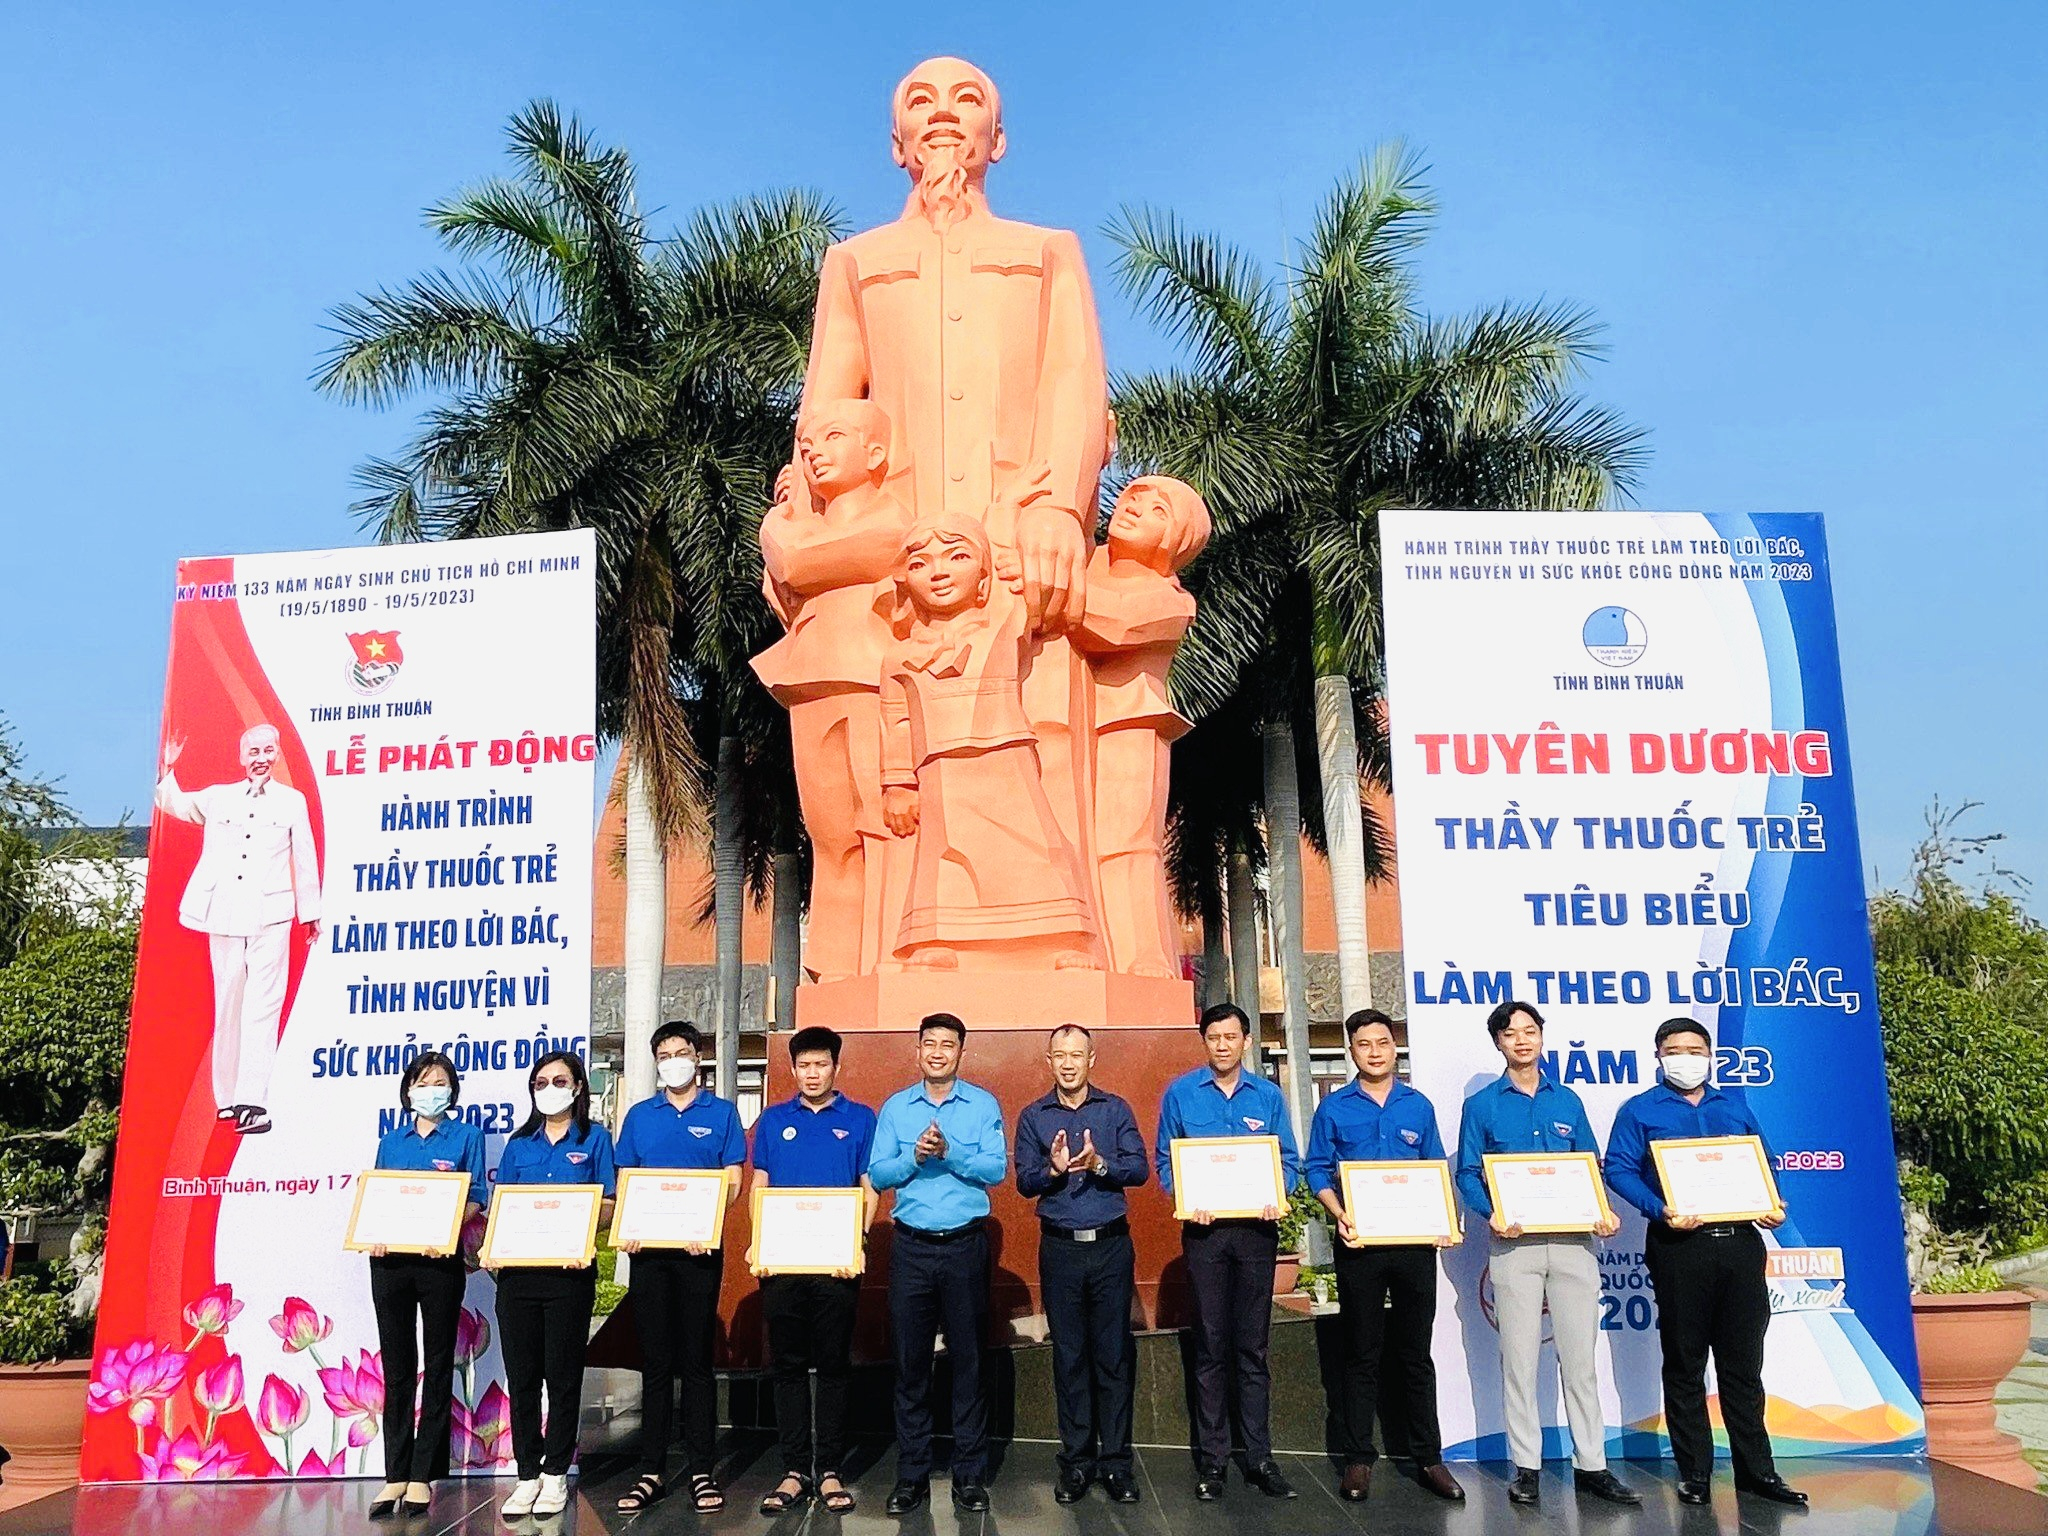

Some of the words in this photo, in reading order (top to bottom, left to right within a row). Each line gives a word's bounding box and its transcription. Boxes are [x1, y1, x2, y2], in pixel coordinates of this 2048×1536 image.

[1405, 538, 1447, 555] HÀNH
[1454, 538, 1502, 555] TRÌNH
[1509, 535, 1549, 555] THẦY
[1556, 535, 1610, 555] THUỐC
[1617, 536, 1645, 555] TRẺ
[1652, 537, 1683, 555] LÀM
[1689, 540, 1729, 555] THEO
[1766, 536, 1804, 557] BÁC,
[244, 581, 269, 596] 133
[314, 573, 352, 590] NGÀY
[359, 571, 394, 587] SINH
[438, 564, 472, 582] TỊCH
[507, 557, 533, 575] CHÍ
[540, 555, 580, 573] MINH
[1405, 563, 1442, 580] TÌNH
[1450, 563, 1512, 582] NGUYỆN
[1519, 563, 1535, 580] VÌ
[1541, 563, 1574, 580] SỨC
[1581, 561, 1622, 580] KHỎE
[1629, 562, 1672, 582] CỘNG
[1770, 563, 1812, 580] 2023
[1594, 673, 1630, 690] BÌNH
[1634, 672, 1684, 693] THUẬN
[347, 702, 381, 720] BÌNH
[386, 698, 432, 719] THUẬN
[326, 734, 366, 776] LỄ
[379, 735, 478, 773] PHÁT
[488, 730, 594, 773] ĐỘNG
[1414, 721, 1610, 775] TUYÊN
[1630, 728, 1832, 776] DƯƠNG
[381, 794, 450, 831] HÀNH
[457, 789, 533, 827] TRÌNH
[1435, 801, 1559, 850] THẦY
[1574, 801, 1725, 850] THUỐC
[1738, 803, 1825, 851] TRẺ
[353, 848, 418, 892] THẦY
[425, 843, 505, 889] THUỐC
[511, 844, 558, 883] TRẺ
[1524, 884, 1628, 926] TIÊU
[1645, 873, 1749, 927] BIỂU
[332, 915, 388, 953] LÀM
[395, 917, 457, 950] THEO
[465, 909, 504, 947] LỜI
[511, 906, 568, 949] BÁC,
[347, 975, 406, 1014] TÌNH
[413, 970, 516, 1016] NGUYỆN
[524, 966, 550, 1005] VÌ
[1413, 961, 1513, 1005] LÀM
[1528, 970, 1651, 1005] THEO
[1667, 961, 1739, 1006] LỜI
[1752, 959, 1860, 1013] BÁC,
[312, 1038, 359, 1078] SỨC
[210, 1177, 271, 1196] Thuận,
[275, 1176, 319, 1195] ngày
[1770, 1251, 1836, 1277] THUẬN
[1598, 1294, 1660, 1331] 20
